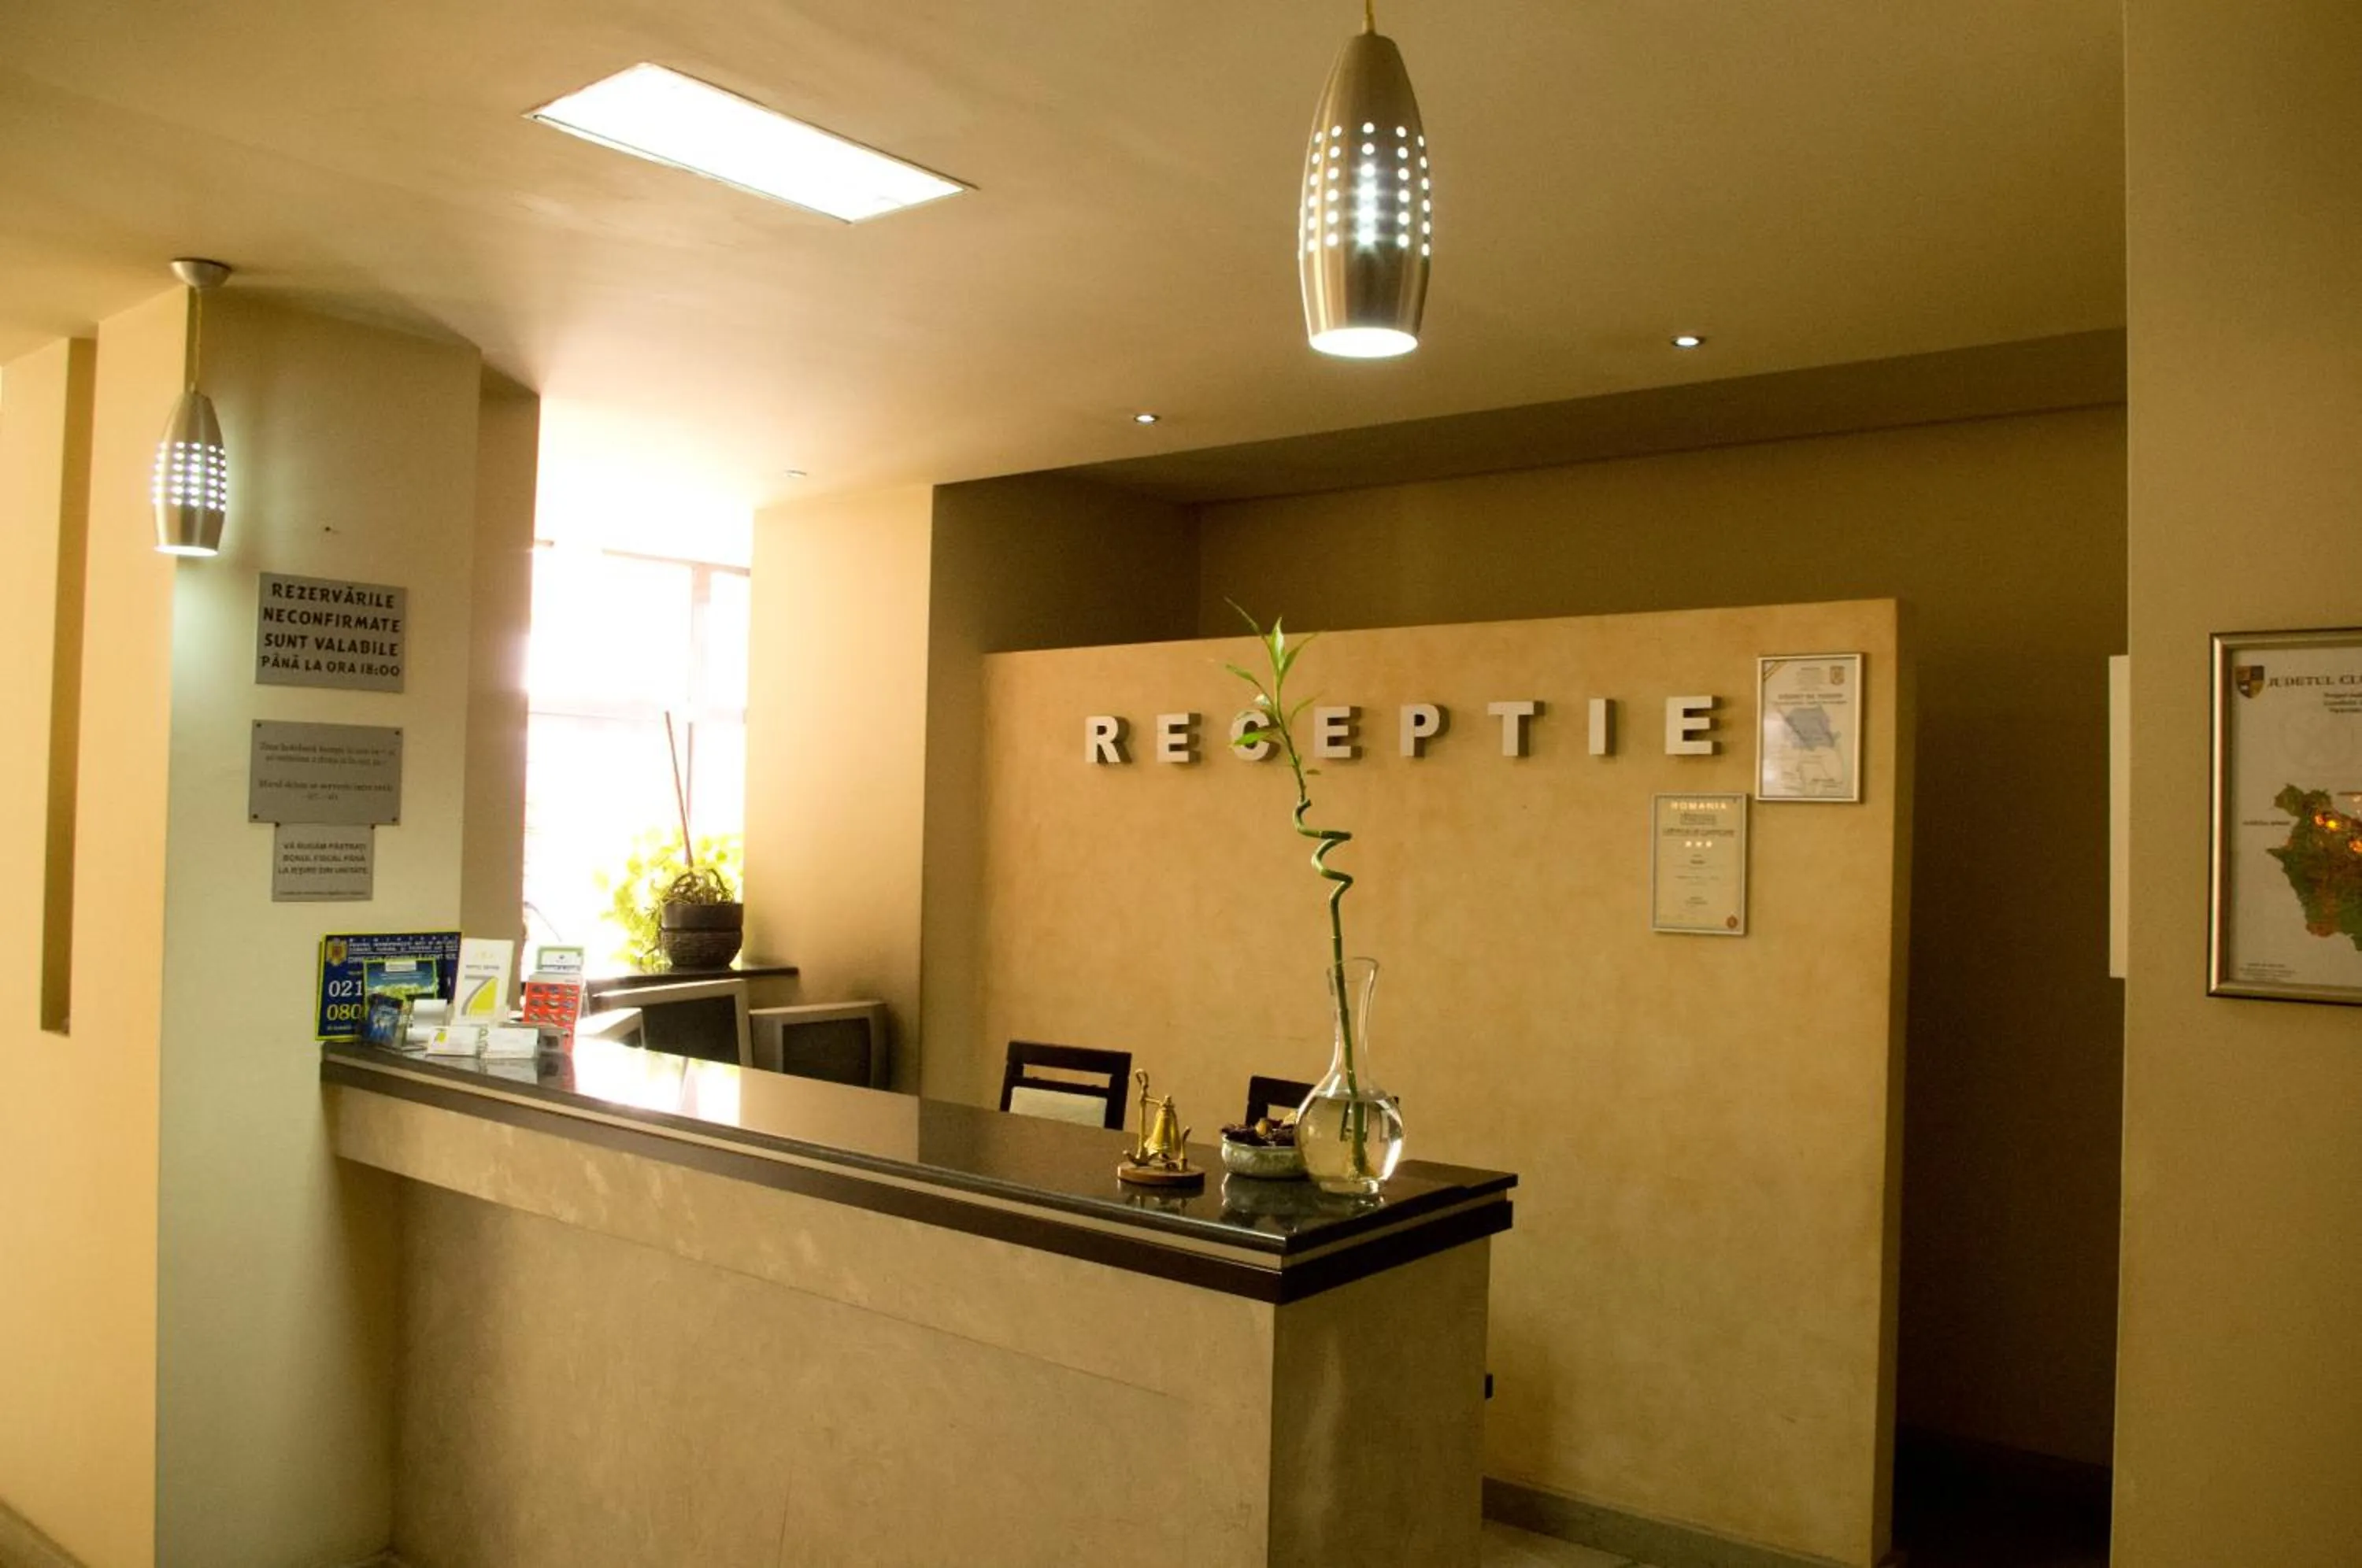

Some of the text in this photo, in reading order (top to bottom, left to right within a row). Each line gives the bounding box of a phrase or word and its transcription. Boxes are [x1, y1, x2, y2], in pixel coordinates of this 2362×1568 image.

[272, 582, 394, 609] REZERVĂRILE
[263, 607, 401, 633] NECONFIRMATE
[264, 633, 398, 656] SUNT VALABILE
[305, 660, 322, 672] LA
[327, 661, 356, 675] ORA
[1084, 695, 1715, 764] RECEPTIE
[328, 979, 363, 997] 021
